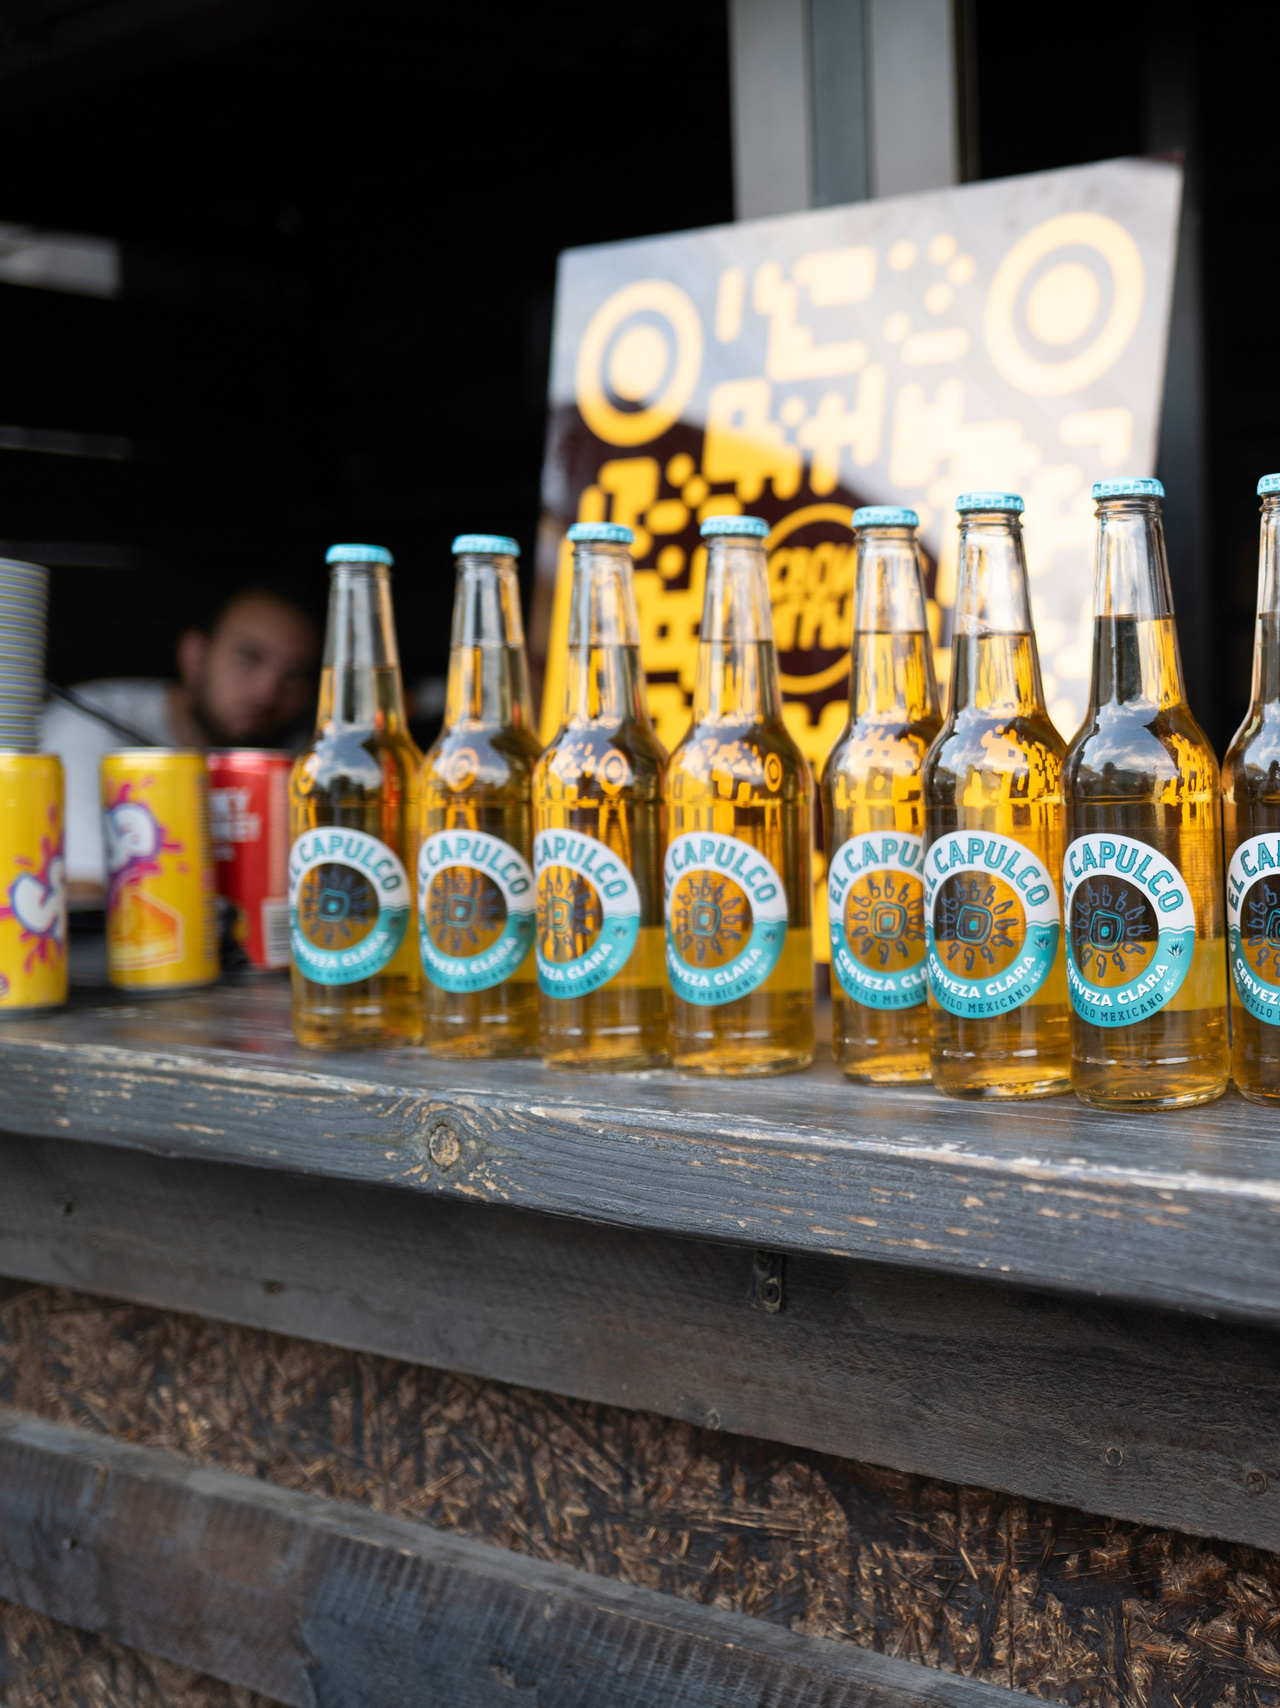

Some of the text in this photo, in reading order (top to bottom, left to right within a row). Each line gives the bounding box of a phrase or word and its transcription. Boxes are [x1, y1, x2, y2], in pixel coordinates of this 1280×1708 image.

[298, 835, 402, 891] CAPULCO
[426, 838, 530, 895] CAPULCO
[671, 839, 777, 903] CAPULCO
[829, 838, 923, 906] EL CAPU
[925, 838, 1050, 908] EL CAPULCO
[1069, 840, 1184, 913] CAPULCO
[1228, 874, 1245, 912] EL
[537, 953, 564, 981] VEZA
[567, 943, 613, 980] CLARA
[713, 948, 762, 985] CLARA
[838, 948, 897, 991] CERVEZA
[901, 966, 927, 989] CLA
[929, 953, 981, 999] CERVEZA
[985, 955, 1036, 997] CLARA
[1067, 959, 1170, 1007] CERVEZA CLARA
[883, 985, 928, 1006] MEXIC
[968, 984, 1031, 1013] MEXICANO
[1100, 992, 1164, 1021] MEXICANO
[1241, 987, 1272, 1018] ESTILO
